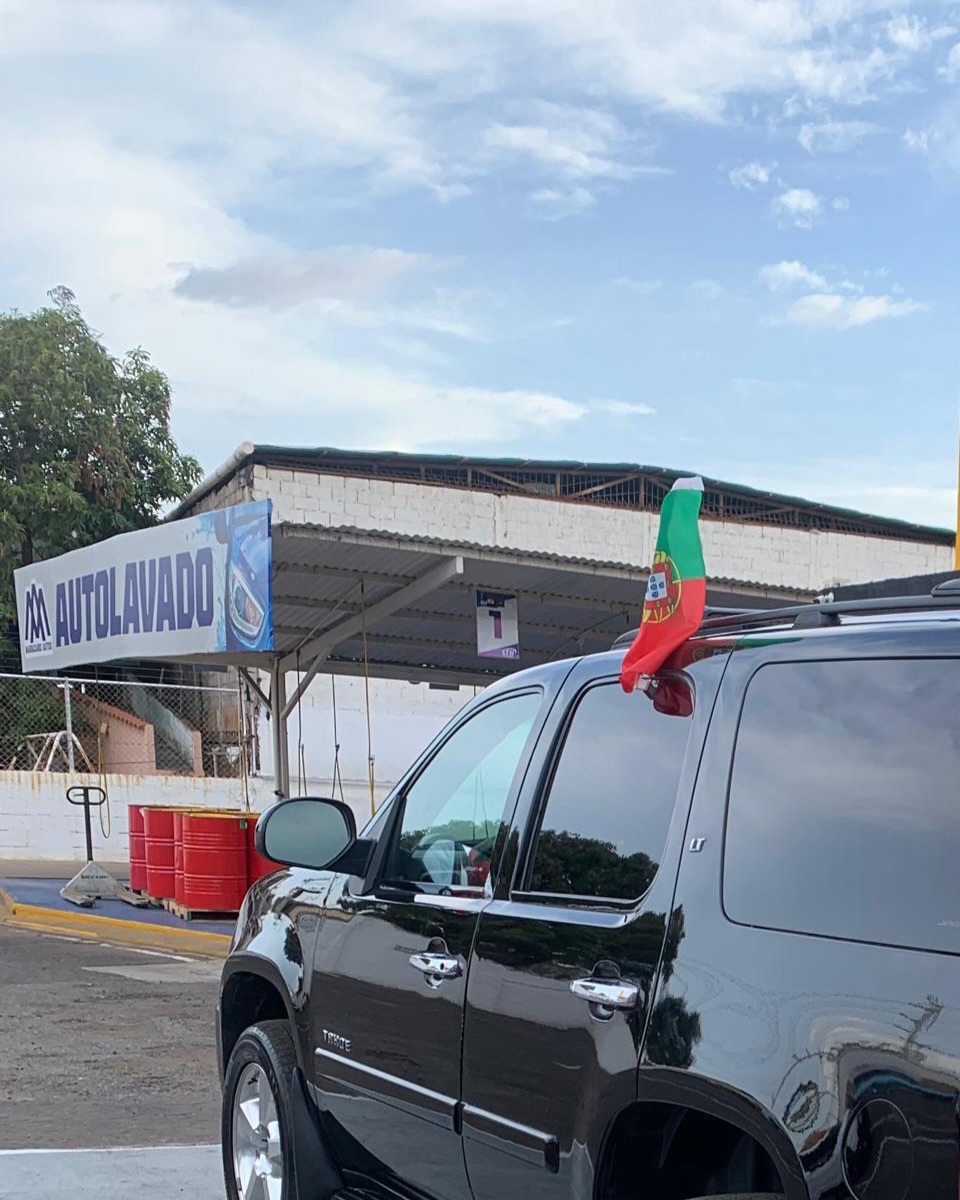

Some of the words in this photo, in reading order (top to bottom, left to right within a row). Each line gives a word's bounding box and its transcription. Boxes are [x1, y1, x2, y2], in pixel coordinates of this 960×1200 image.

[55, 547, 214, 648] AUTOLAVADO
[488, 609, 503, 639] 1
[322, 1028, 352, 1052] TAHOE
